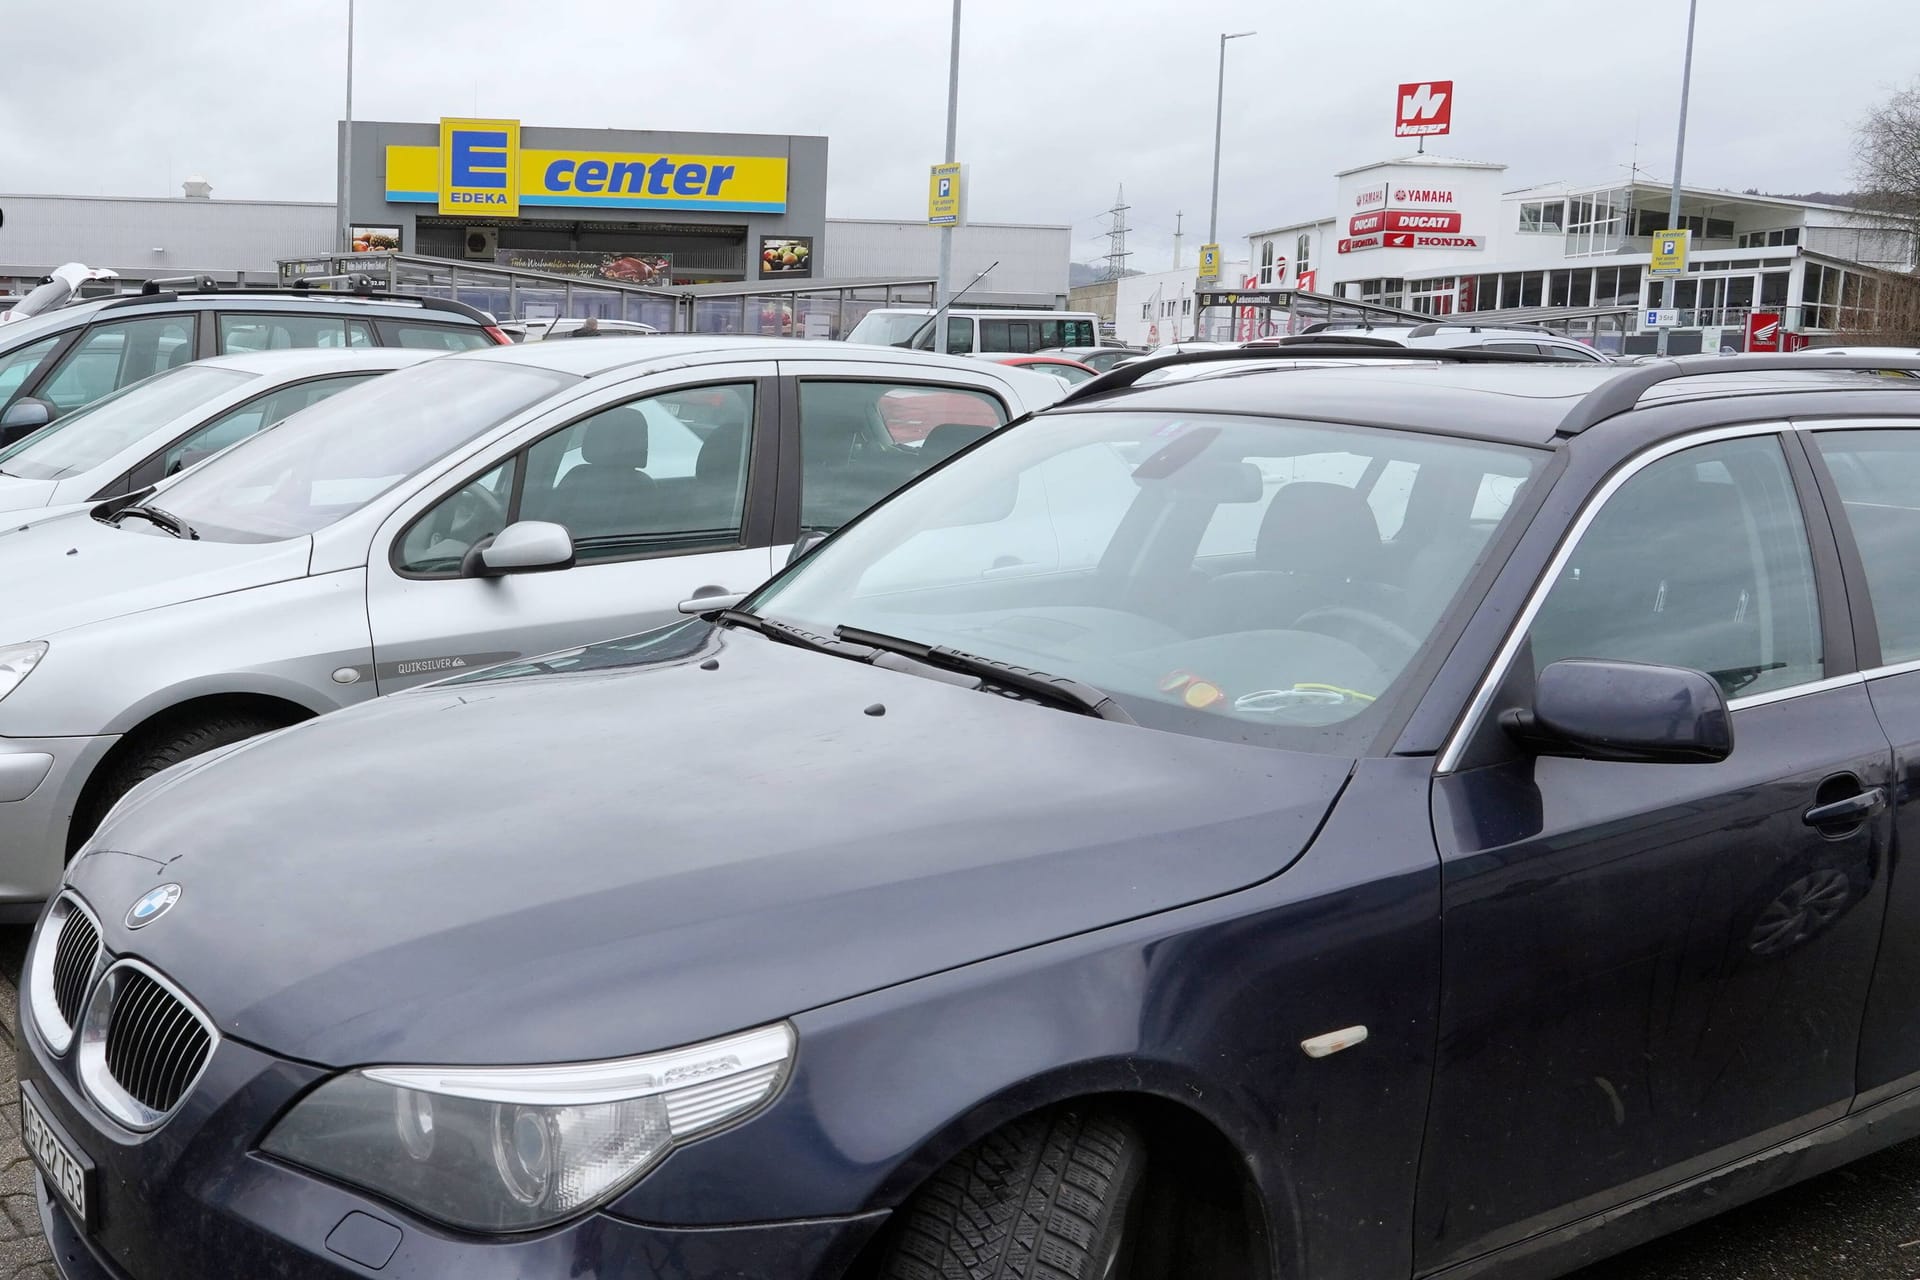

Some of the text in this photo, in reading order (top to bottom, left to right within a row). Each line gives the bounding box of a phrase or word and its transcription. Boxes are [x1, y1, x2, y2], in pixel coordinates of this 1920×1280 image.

[451, 130, 736, 197] E center
[940, 179, 949, 197] P
[450, 191, 508, 205] EDEKA
[1362, 190, 1383, 206] YAMAHA
[1408, 189, 1453, 203] YAMAHA
[1353, 216, 1378, 231] DUCATI
[1398, 215, 1450, 229] DUCATI
[1351, 237, 1379, 249] HONDA
[1417, 237, 1477, 247] HONDA
[1663, 241, 1674, 254] P
[398, 658, 451, 674] QUIKSILVER
